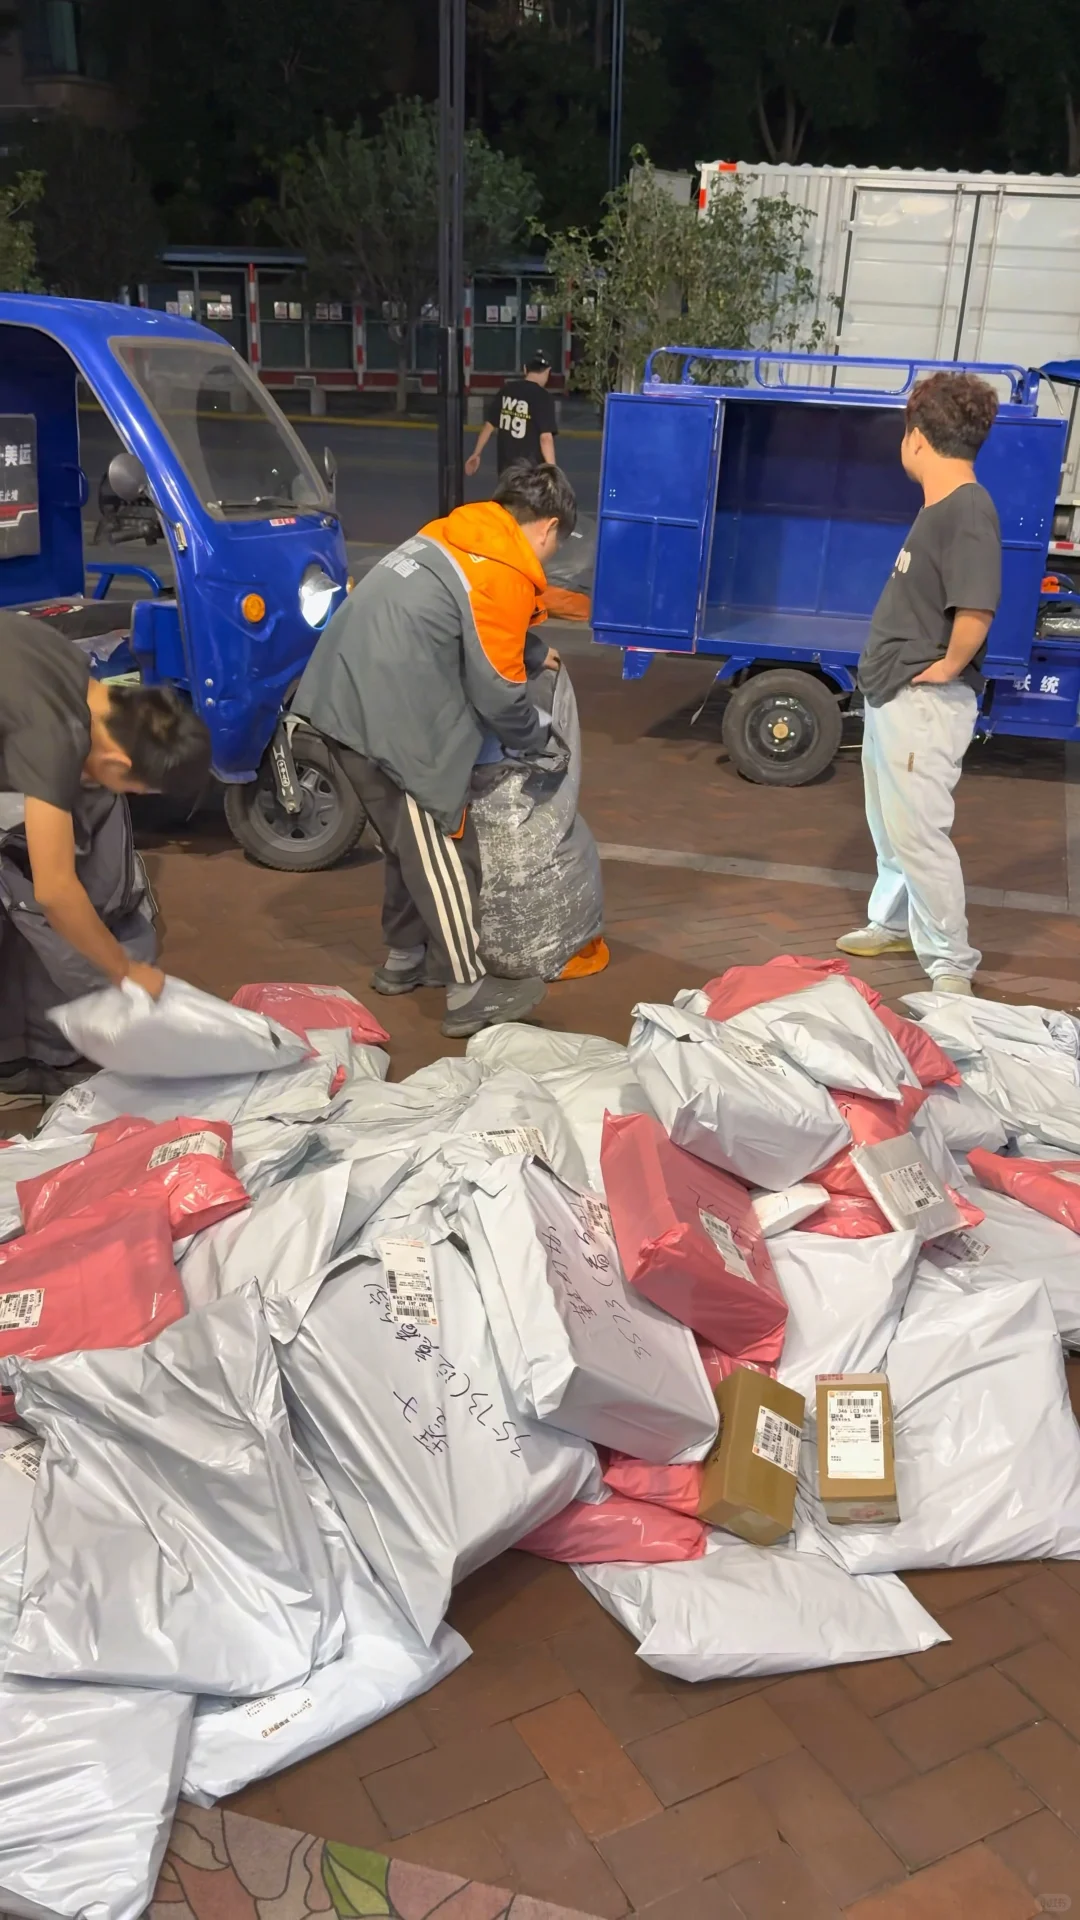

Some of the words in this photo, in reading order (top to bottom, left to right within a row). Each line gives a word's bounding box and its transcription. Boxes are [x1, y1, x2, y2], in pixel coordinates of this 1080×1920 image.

[502, 396, 528, 414] wa
[499, 413, 527, 439] ng
[0, 444, 32, 466] 美运
